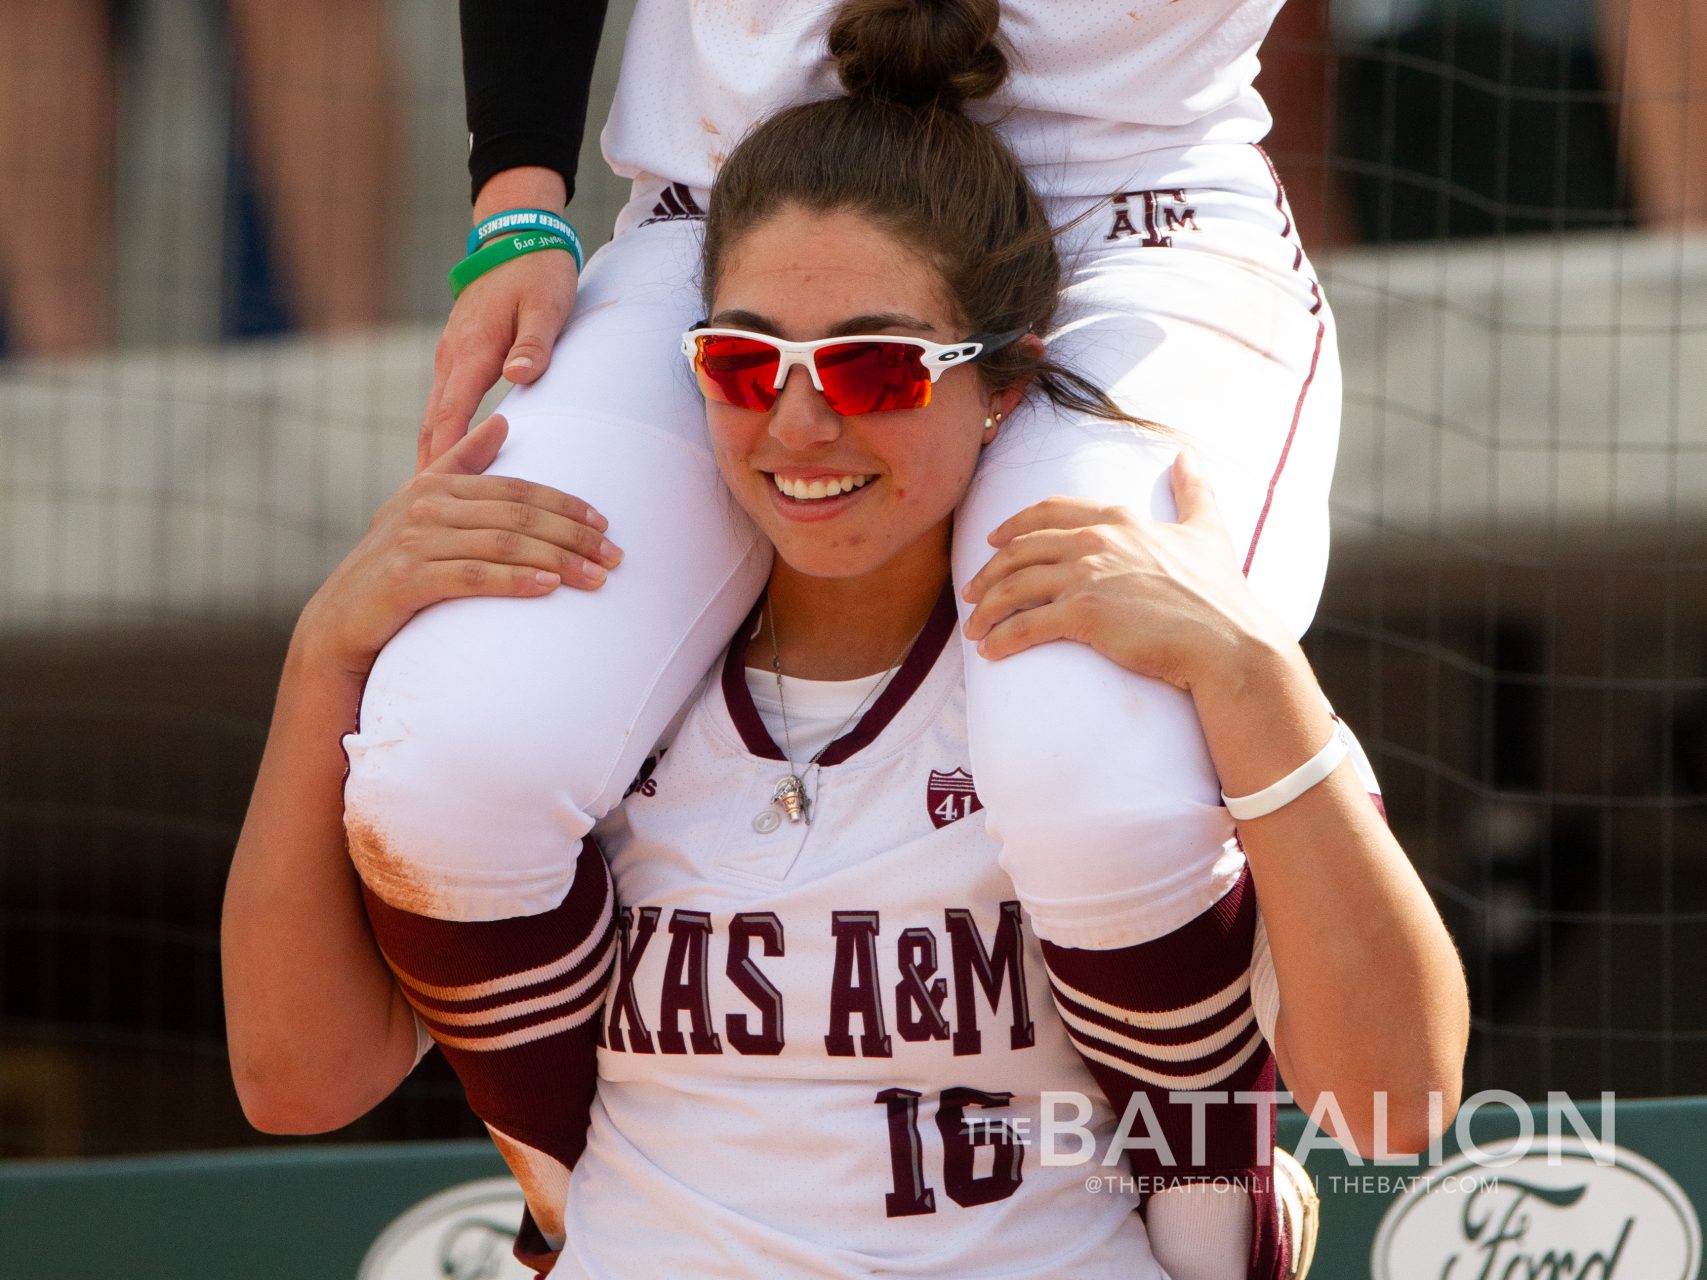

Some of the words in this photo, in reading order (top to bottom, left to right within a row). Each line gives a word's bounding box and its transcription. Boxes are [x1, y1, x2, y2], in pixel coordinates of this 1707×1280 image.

[478, 212, 538, 240] AWARENESS
[539, 214, 575, 243] CANCER
[934, 792, 972, 821] 41
[598, 905, 785, 1055] XAS
[823, 899, 1036, 1059] A&M
[875, 1087, 1027, 1219] 16
